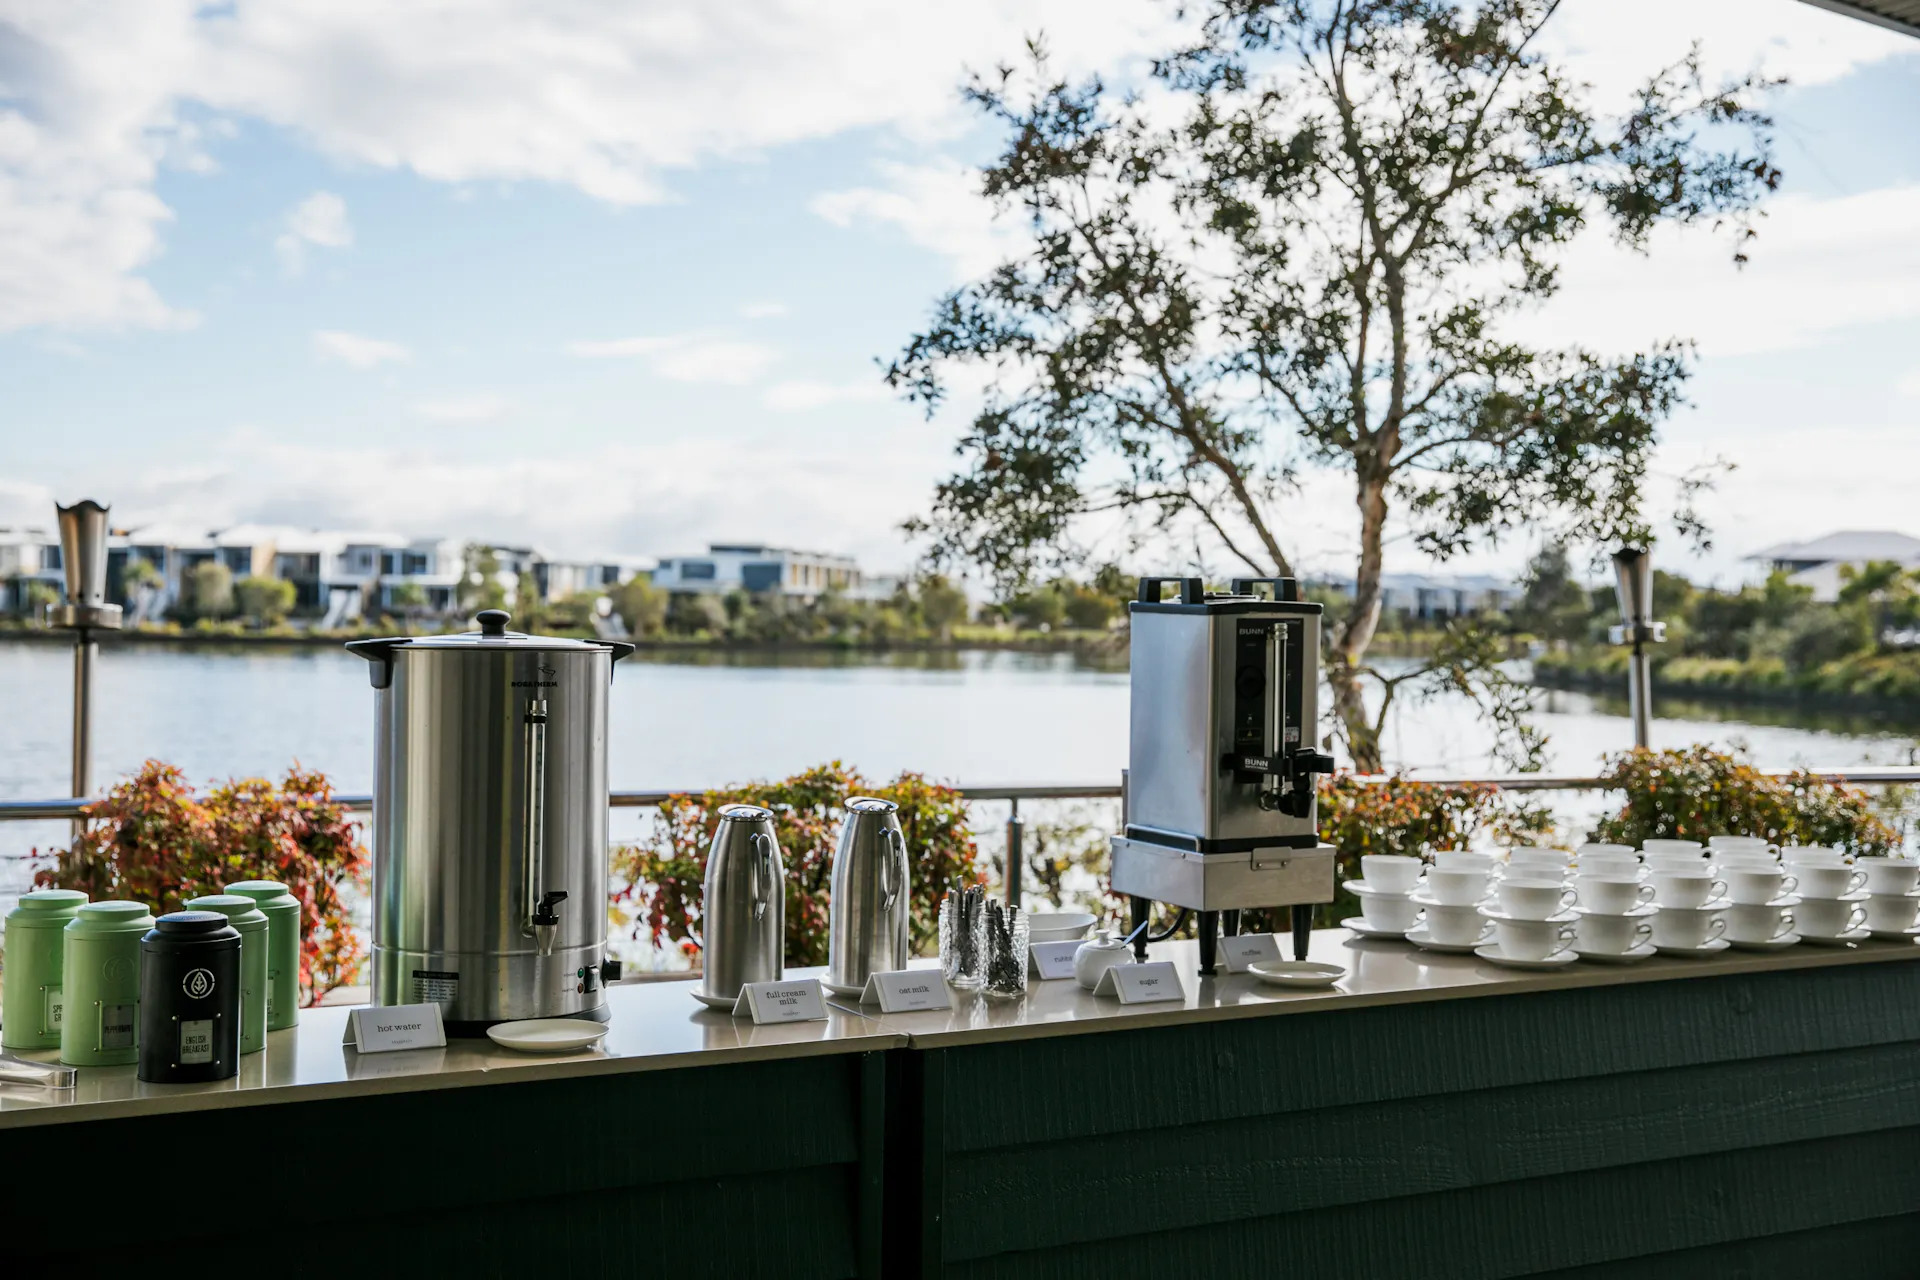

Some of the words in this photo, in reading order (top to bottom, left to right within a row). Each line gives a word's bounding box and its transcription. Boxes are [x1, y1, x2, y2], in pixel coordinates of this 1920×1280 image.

[1244, 758, 1269, 768] BUNN
[912, 985, 930, 993] milk
[766, 991, 780, 999] full
[377, 1024, 394, 1033] hot
[394, 1023, 422, 1031] water
[185, 1035, 207, 1045] ENGLISH
[182, 1044, 210, 1055] BREAKFAST
